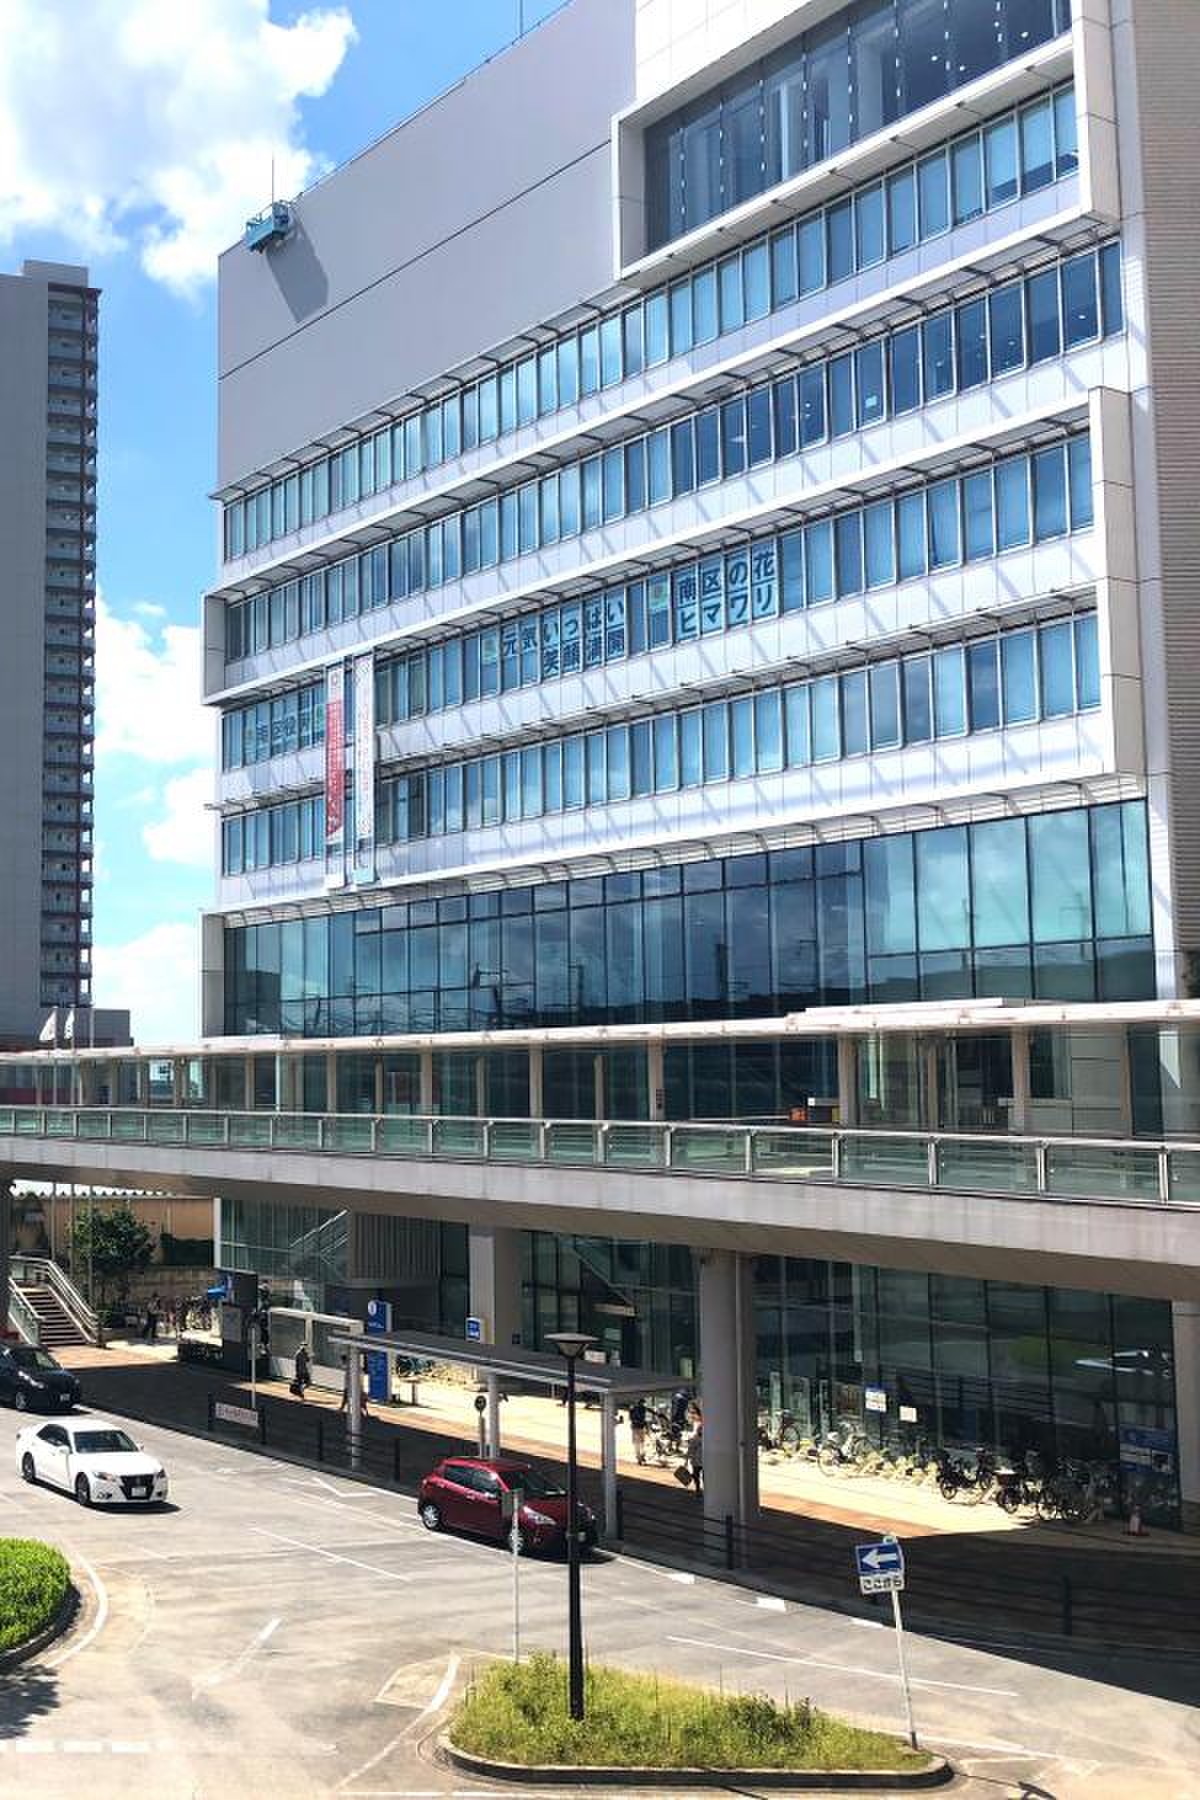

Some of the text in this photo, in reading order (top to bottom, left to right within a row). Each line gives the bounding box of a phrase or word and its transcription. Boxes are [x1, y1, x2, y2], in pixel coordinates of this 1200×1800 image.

[679, 550, 775, 604] 南区の花
[680, 584, 773, 633] ヒマワリ
[863, 1576, 902, 1591] ここから
